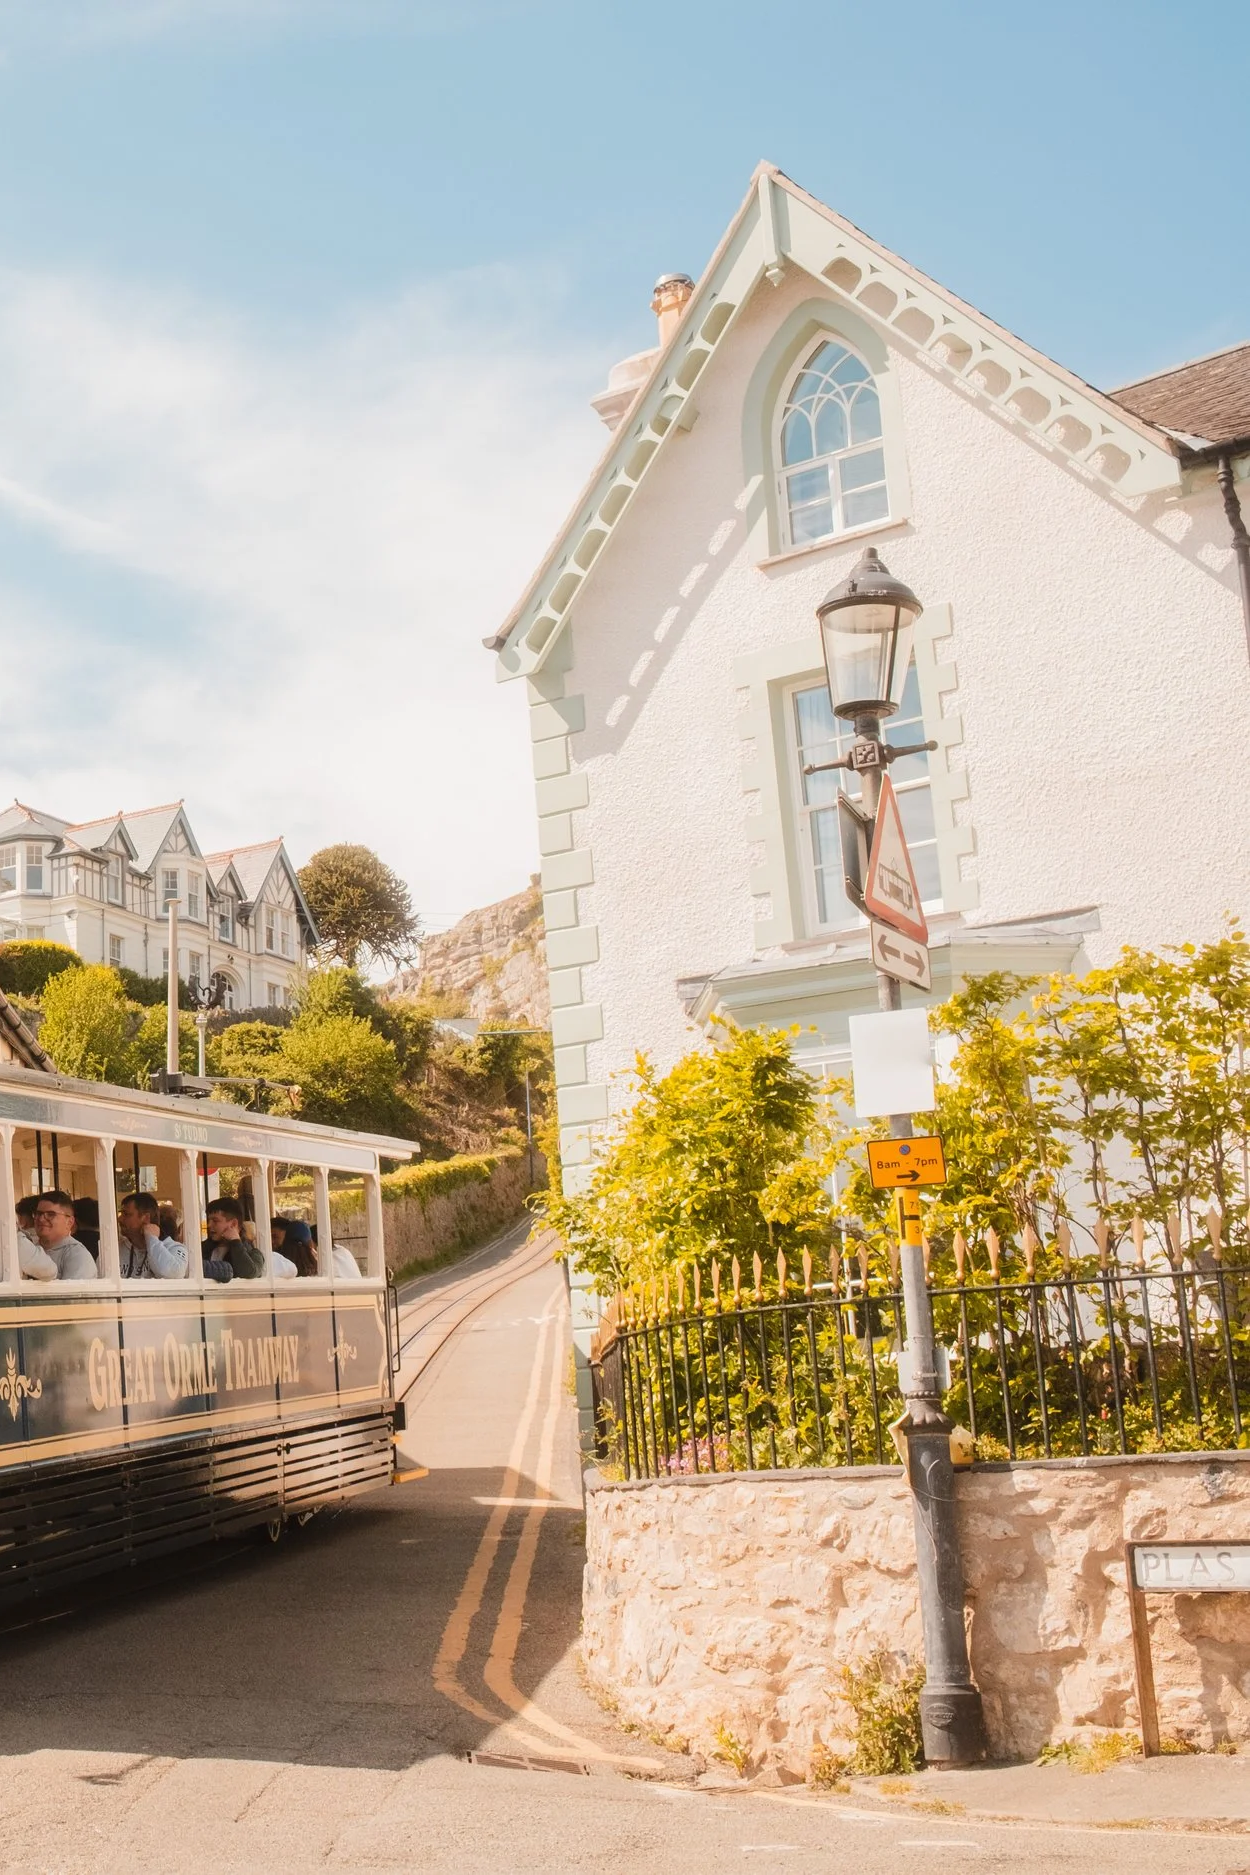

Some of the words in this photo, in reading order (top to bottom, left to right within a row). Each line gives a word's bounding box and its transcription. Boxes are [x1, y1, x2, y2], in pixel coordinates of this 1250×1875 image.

[876, 1161, 900, 1169] 8am
[914, 1158, 938, 1167] 7pm
[88, 1336, 157, 1411] GREAT
[163, 1332, 217, 1400] ORME
[221, 1328, 299, 1391] TRAMWAY
[1142, 1551, 1235, 1582] PLAS
